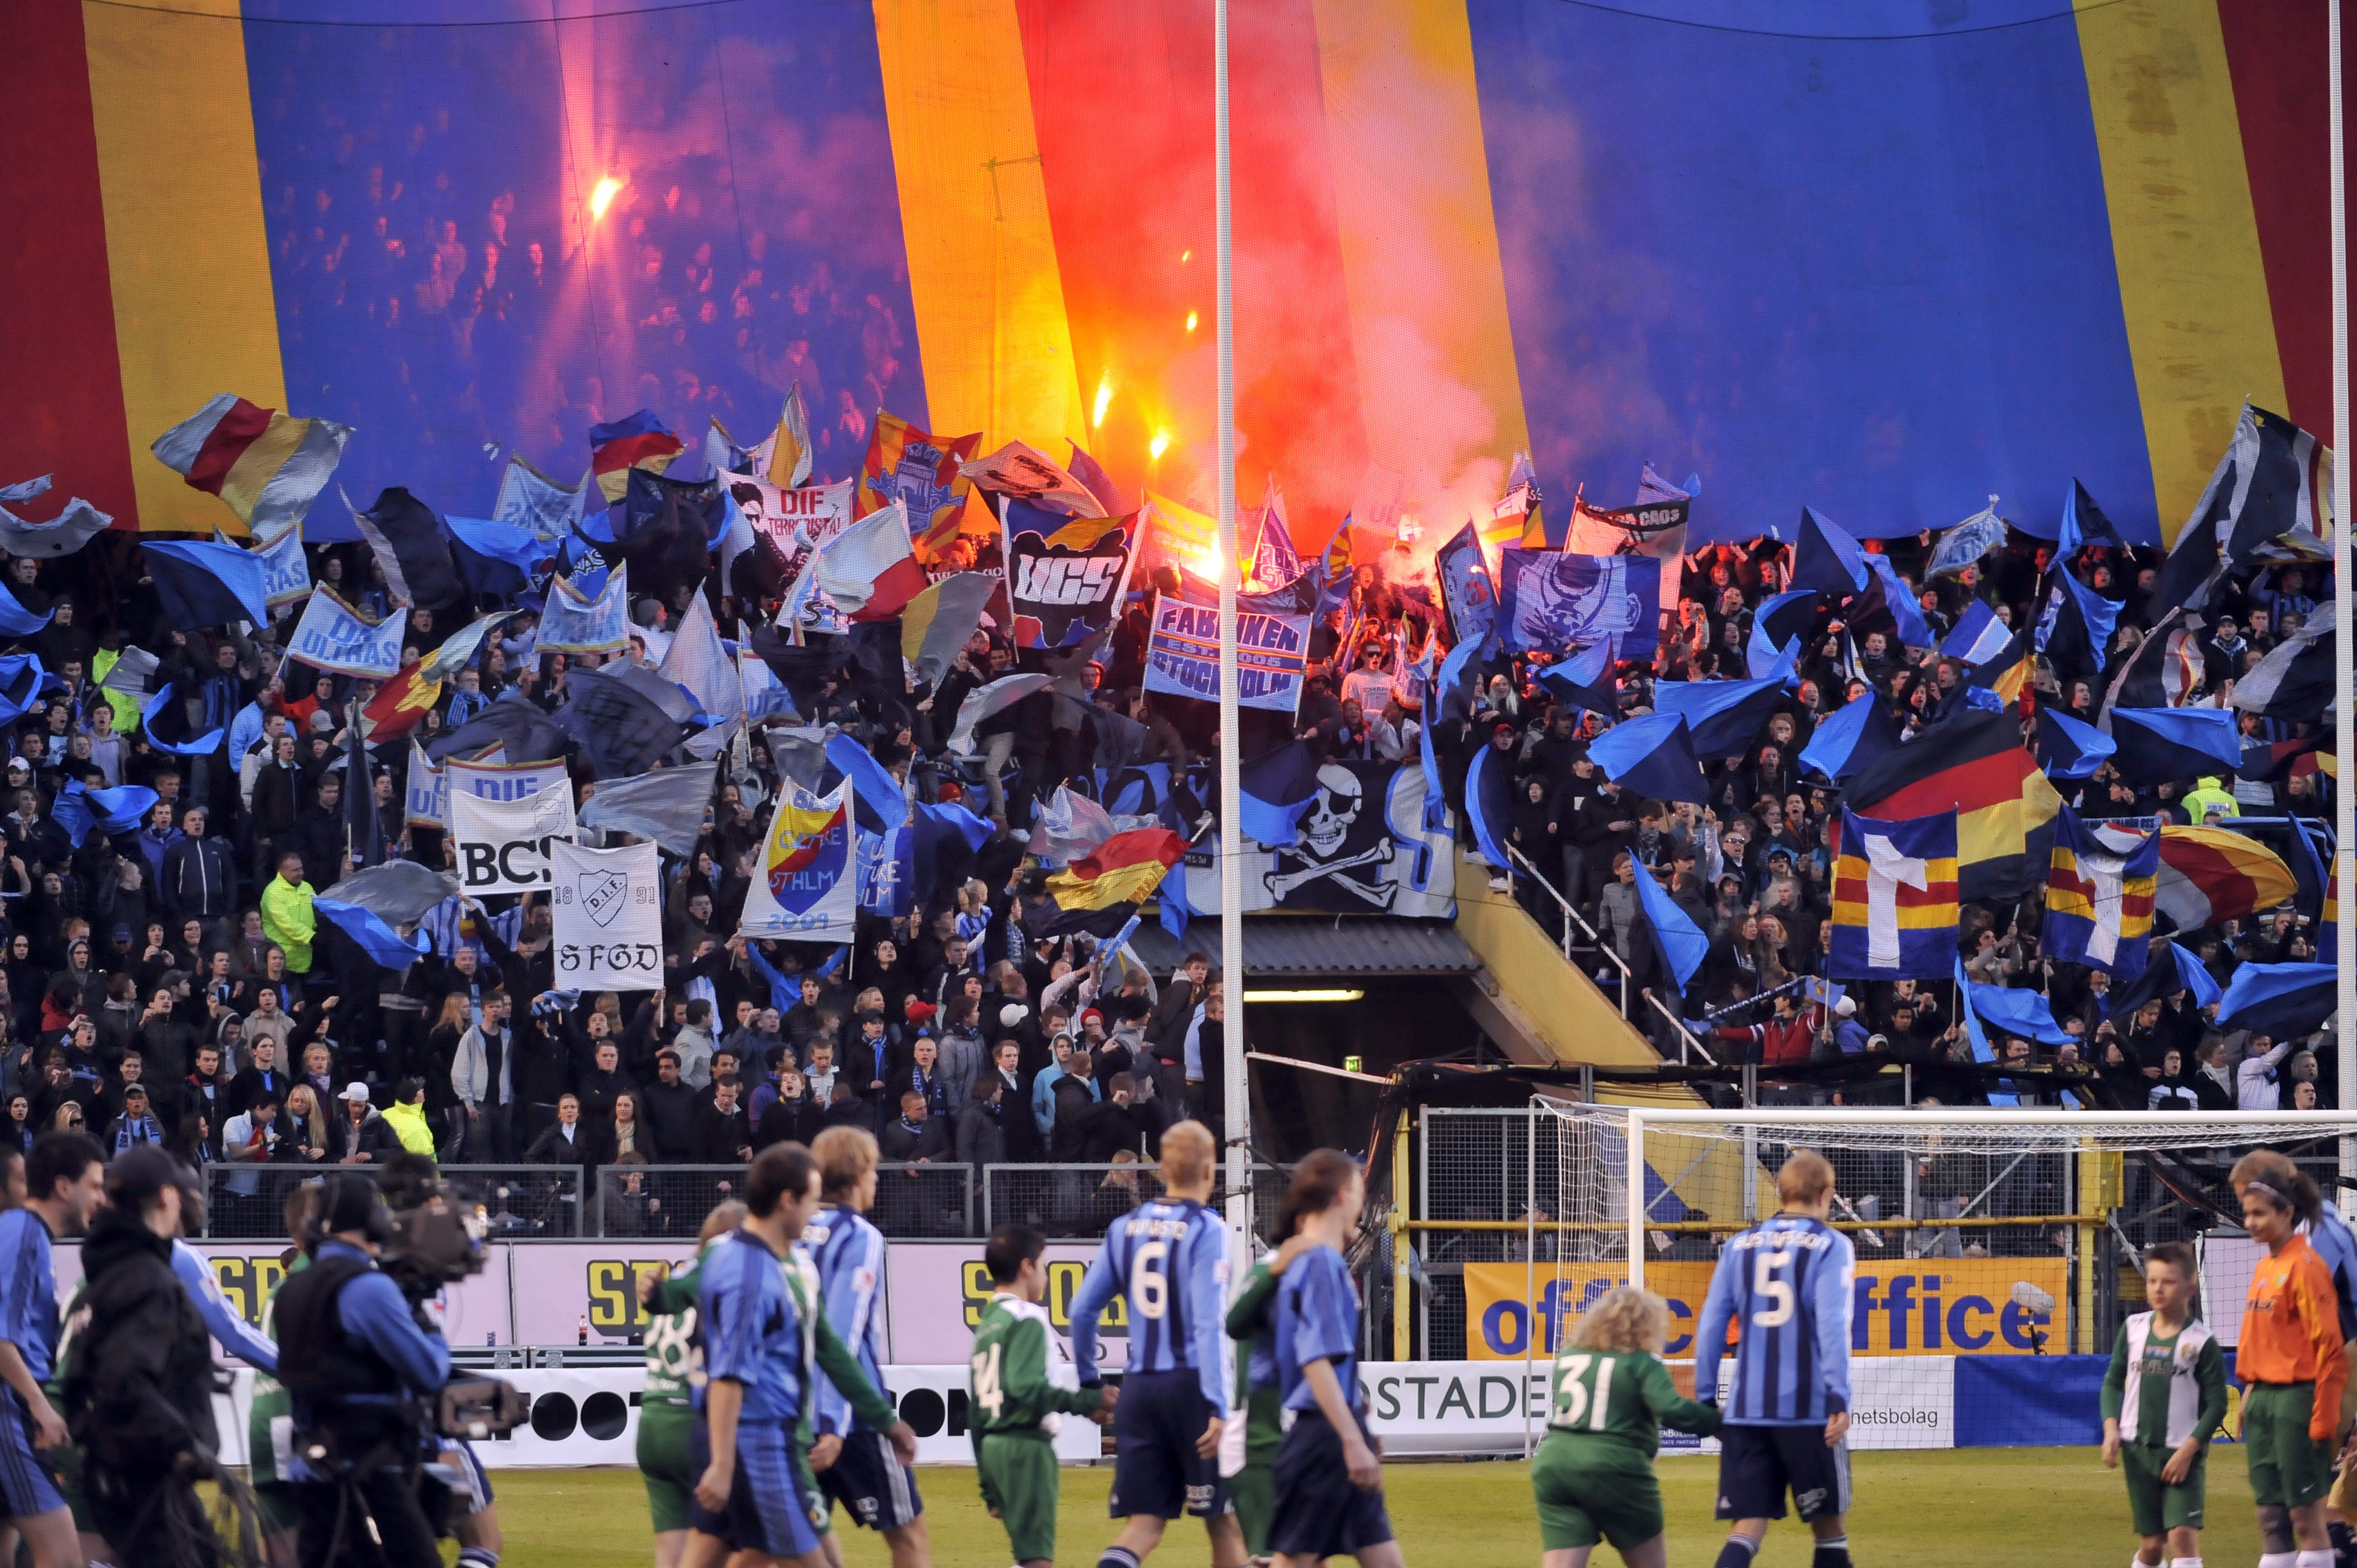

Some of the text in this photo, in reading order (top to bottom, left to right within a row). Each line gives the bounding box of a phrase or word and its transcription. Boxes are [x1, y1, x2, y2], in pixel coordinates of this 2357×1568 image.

[780, 489, 824, 514] DIF
[1639, 508, 1680, 527] CAOS
[1014, 554, 1123, 605] UCS
[1161, 607, 1300, 652] FABIKEN
[1167, 638, 1281, 667] EST. 005
[1153, 651, 1291, 698] STOCKOLM
[793, 789, 841, 812] BLE
[555, 886, 573, 904] 18
[637, 886, 656, 904] 91
[769, 870, 834, 891] STHLM
[768, 912, 829, 930] 2009
[1131, 1241, 1168, 1318] 6
[1752, 1251, 1794, 1327] 5
[1851, 1275, 2051, 1350] ffice
[1360, 1375, 1547, 1421] STADE
[1554, 1354, 1617, 1431] 31
